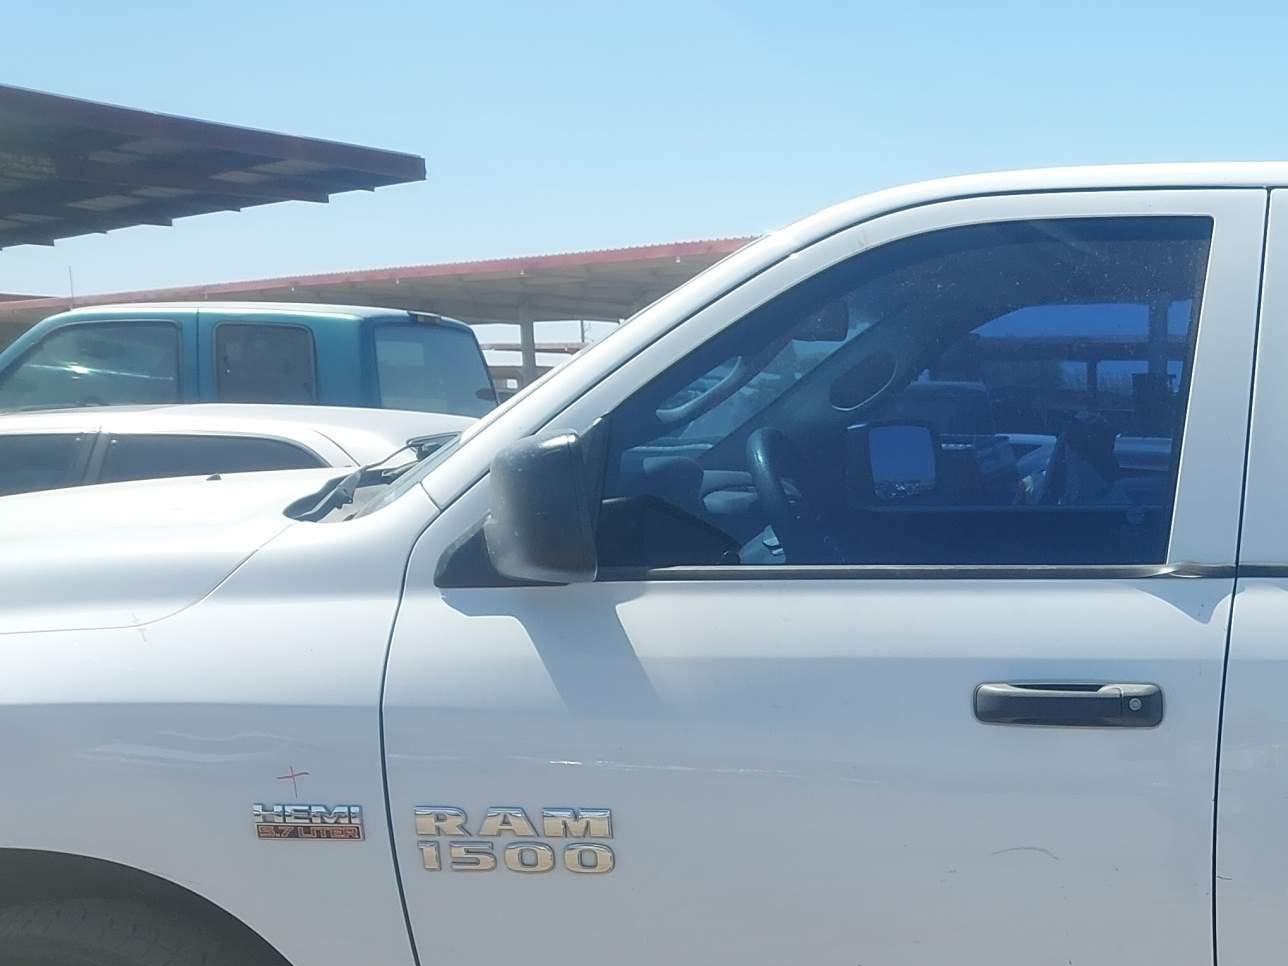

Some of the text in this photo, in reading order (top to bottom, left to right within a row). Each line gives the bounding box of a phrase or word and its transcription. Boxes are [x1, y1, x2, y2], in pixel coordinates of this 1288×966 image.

[253, 804, 361, 823] HEMI
[415, 805, 613, 838] RAM
[259, 826, 359, 839] 5.7 LITER
[418, 840, 615, 873] 1500
